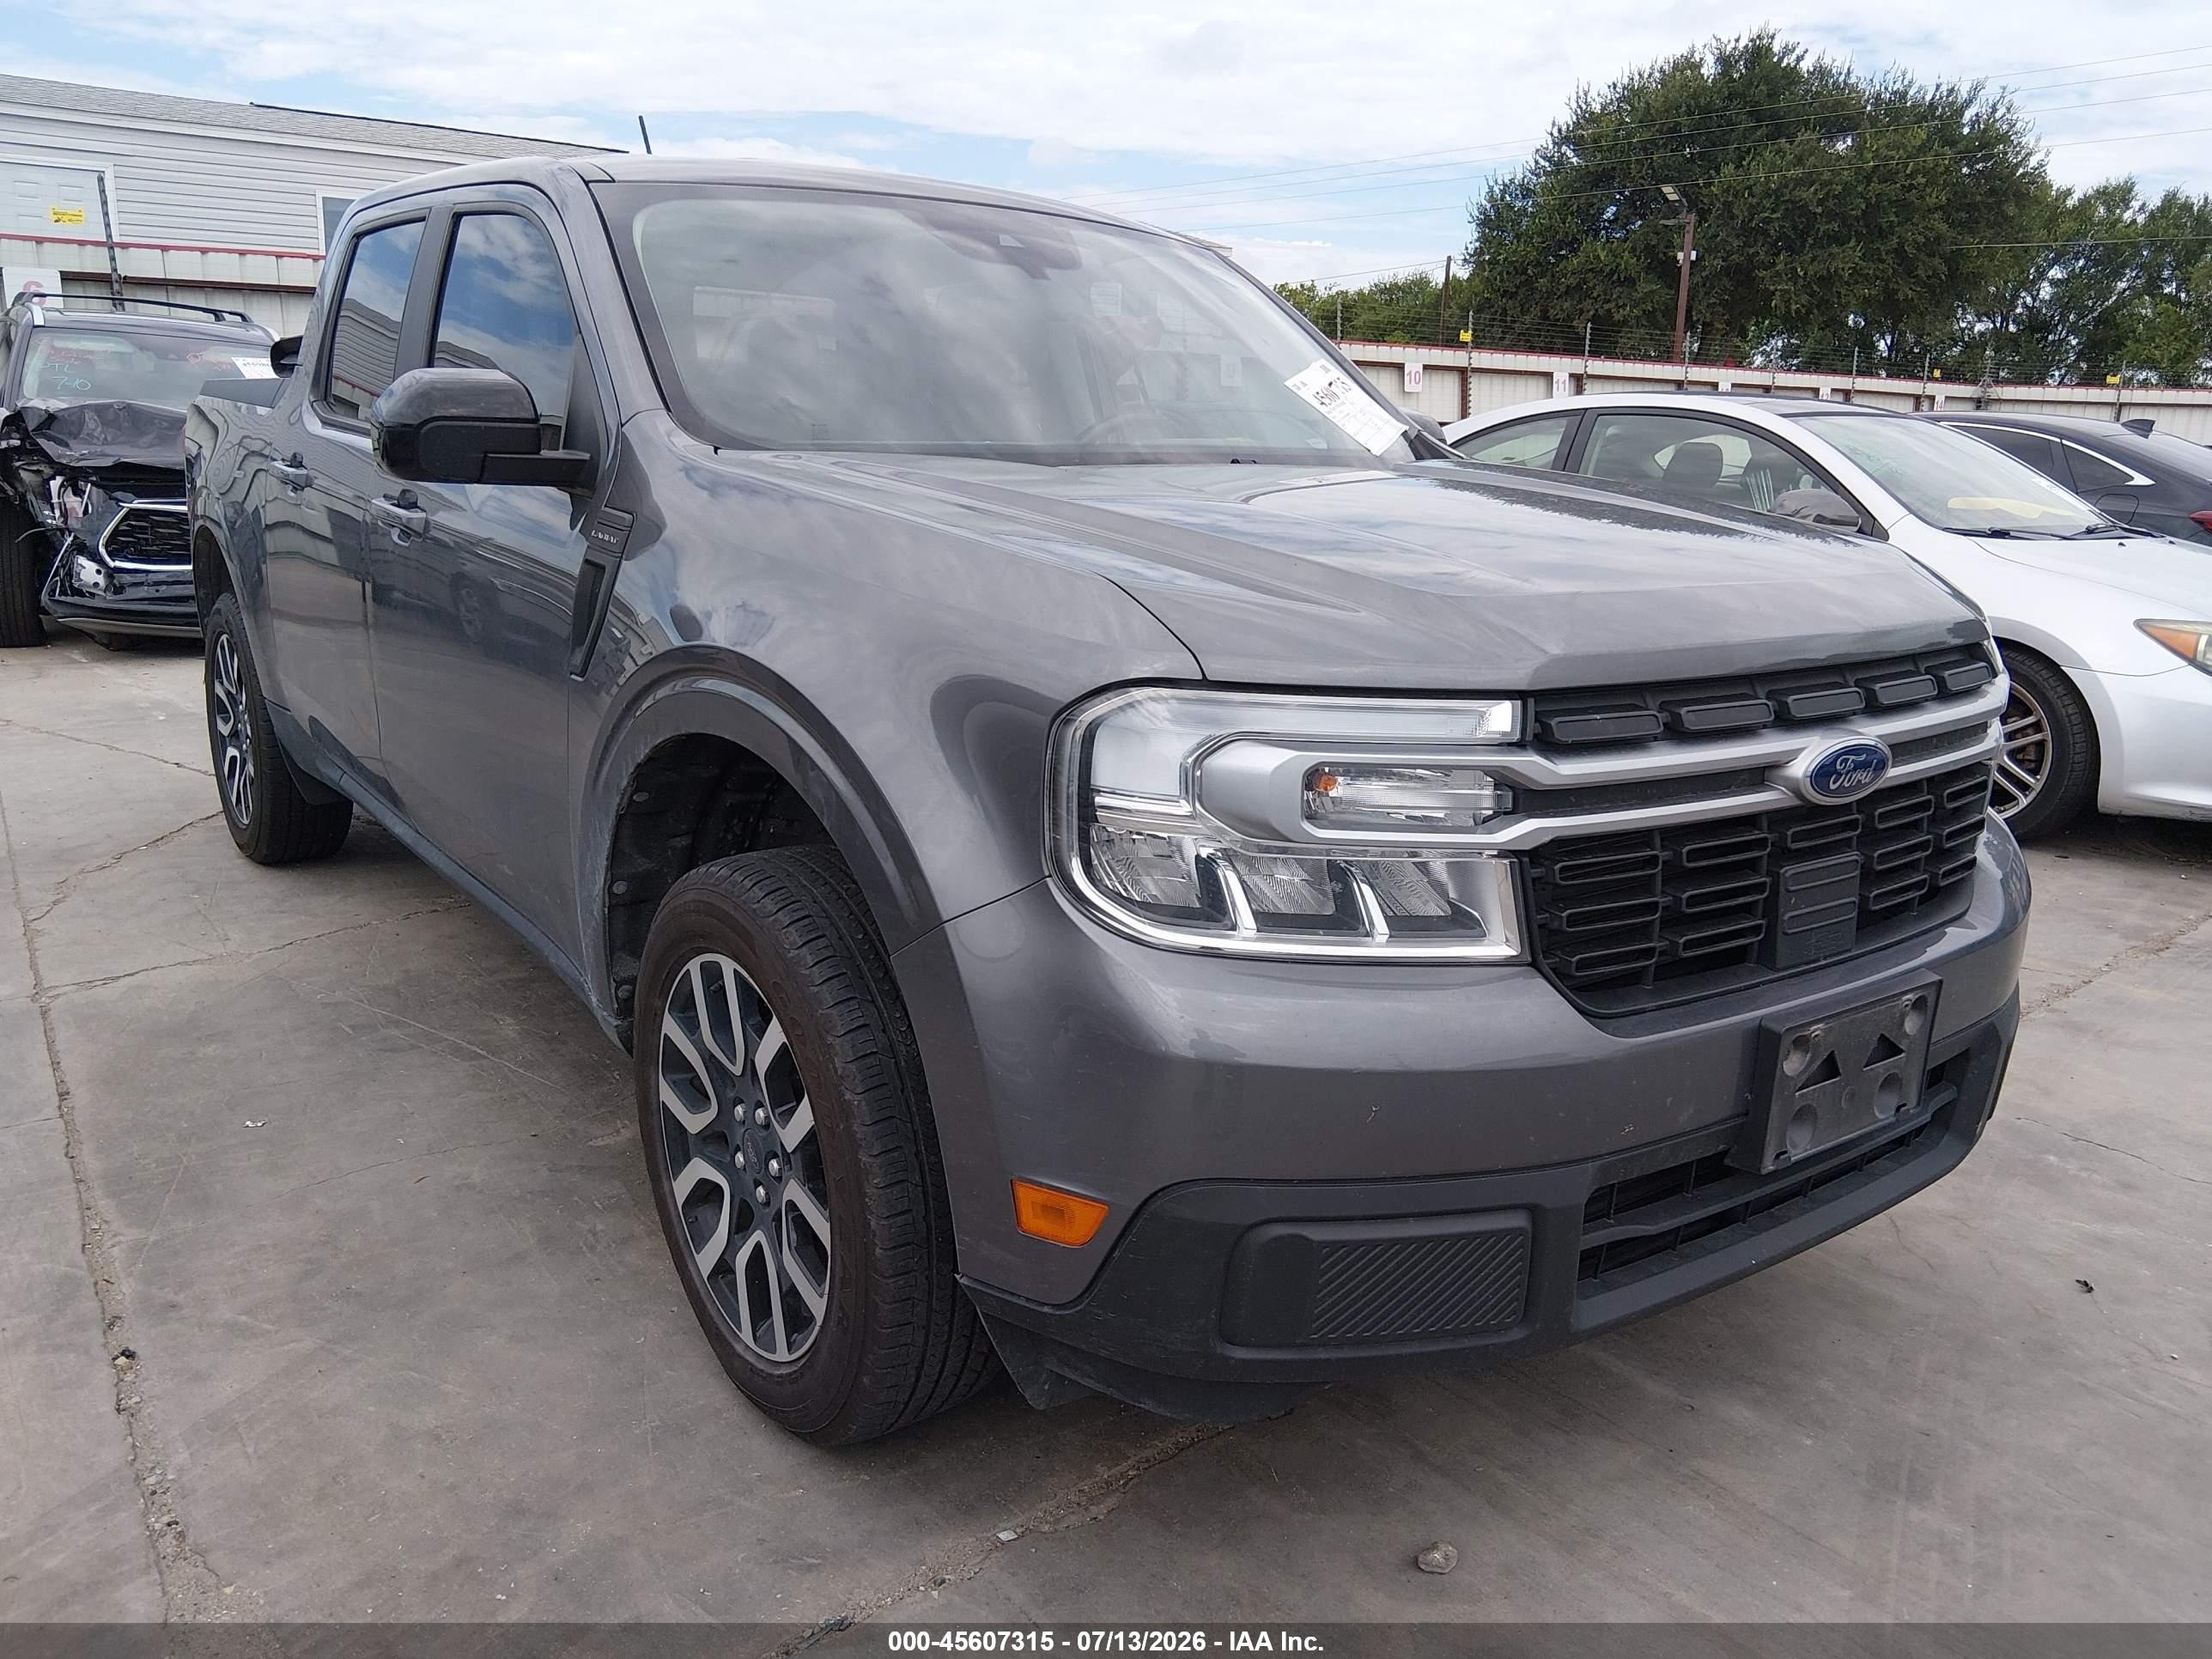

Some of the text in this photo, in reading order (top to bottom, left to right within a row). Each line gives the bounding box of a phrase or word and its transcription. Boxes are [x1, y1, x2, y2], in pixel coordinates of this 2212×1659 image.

[1406, 370, 1421, 386] 10
[1554, 378, 1566, 392] 11
[1829, 753, 1877, 790] Ford
